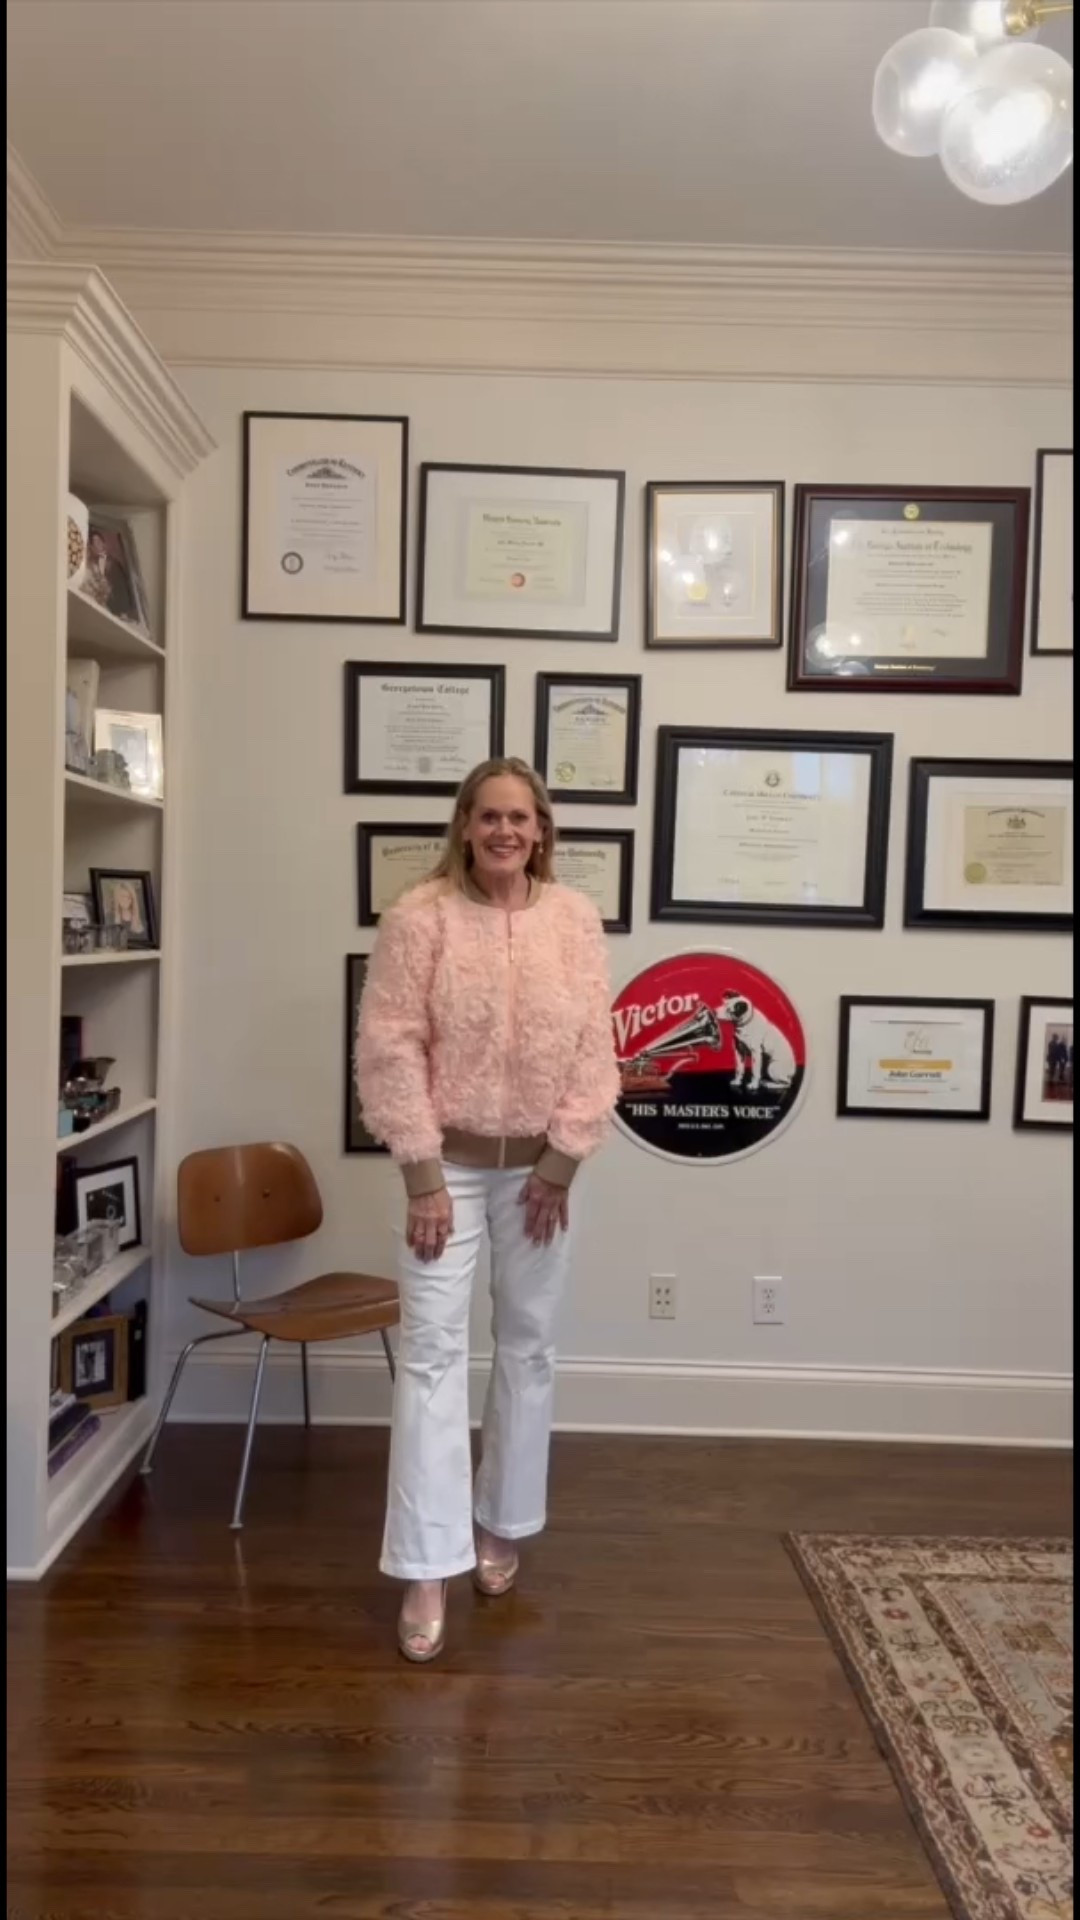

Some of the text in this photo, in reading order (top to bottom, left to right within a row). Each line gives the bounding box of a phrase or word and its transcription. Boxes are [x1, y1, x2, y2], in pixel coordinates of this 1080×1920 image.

[437, 684, 469, 696] College
[610, 993, 699, 1053] Victor
[663, 1104, 730, 1118] MASTER'S
